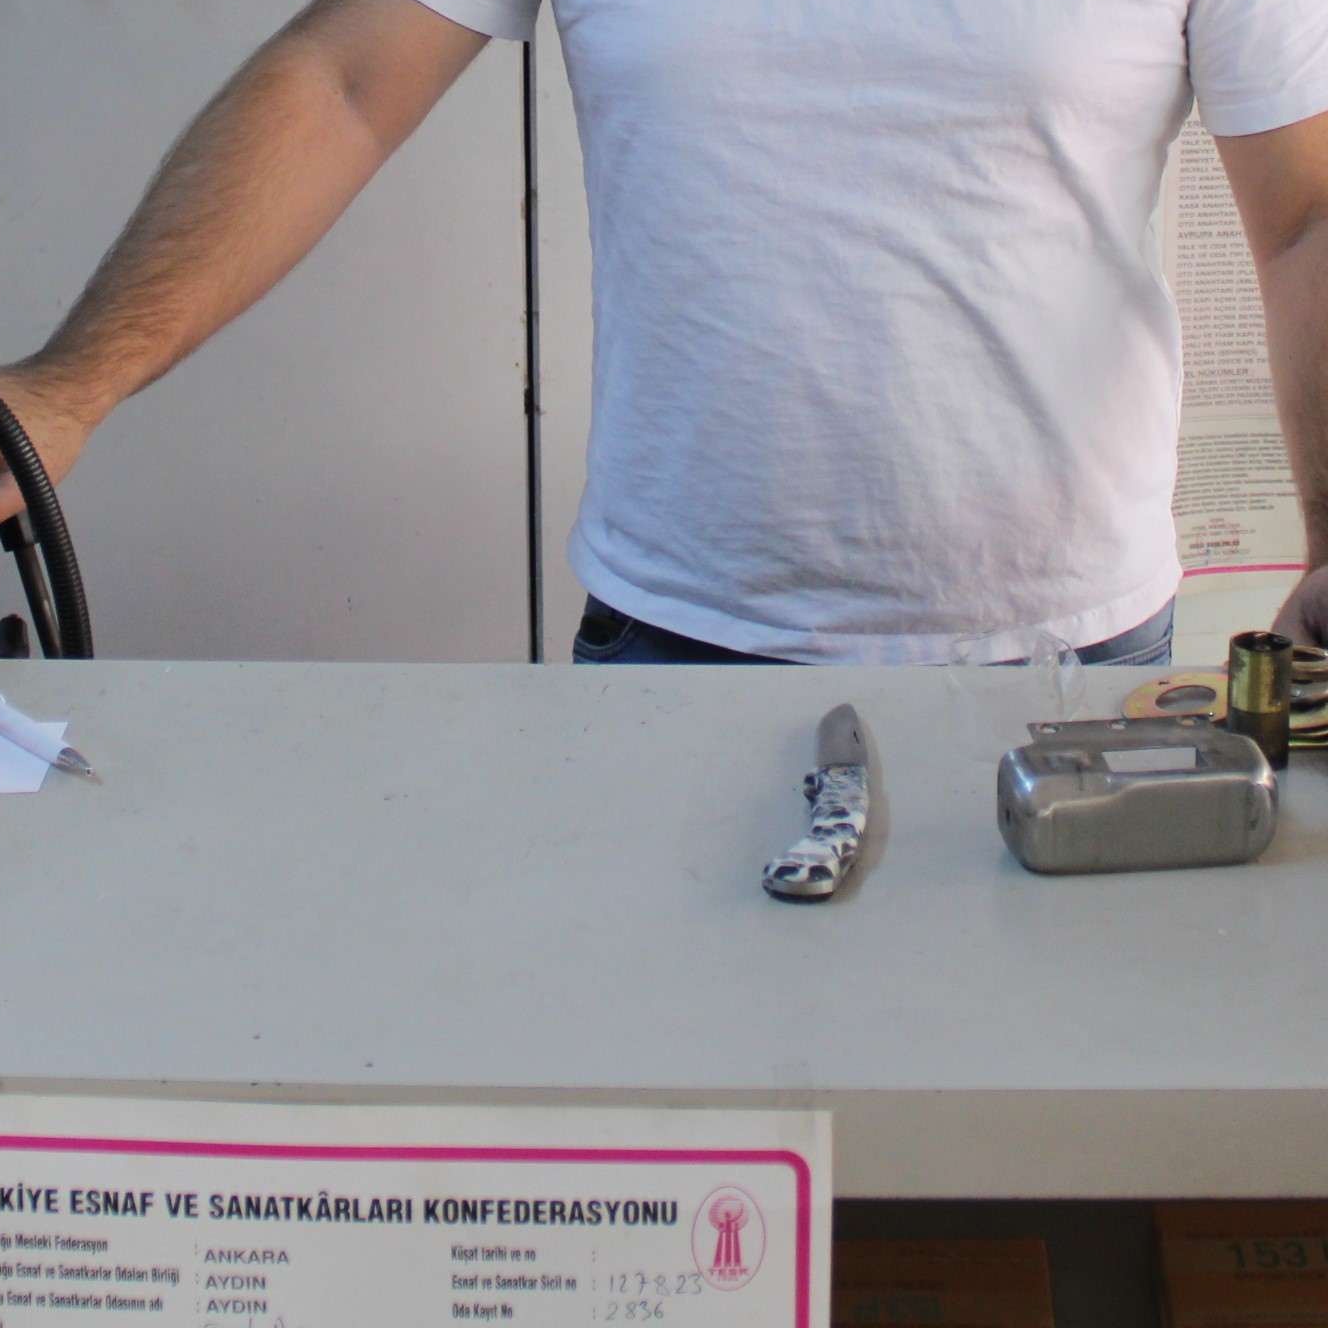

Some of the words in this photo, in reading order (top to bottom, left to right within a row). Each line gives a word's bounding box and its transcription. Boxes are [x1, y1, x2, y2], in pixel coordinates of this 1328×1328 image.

[70, 1189, 154, 1218] ESNAF
[165, 1194, 199, 1219] VE
[208, 1190, 413, 1225] SANATKÂRLARI
[423, 1198, 678, 1227] KONFEDERASYONU
[15, 1233, 52, 1250] Mesleki
[54, 1235, 108, 1255] Federasyon
[204, 1249, 289, 1265] ANKARA
[451, 1245, 478, 1265] Küşat
[481, 1246, 507, 1262] tarihi
[510, 1250, 521, 1262] ve
[524, 1250, 536, 1262] no
[1225, 1240, 1309, 1270] 153
[16, 1262, 41, 1279] Esnaf
[44, 1266, 56, 1279] ve
[58, 1263, 112, 1281] Sanatkarlar
[115, 1265, 148, 1282] Odaları
[151, 1267, 180, 1288] Birliği
[205, 1275, 266, 1290] AYDIN
[451, 1274, 478, 1291] Esnaf
[481, 1279, 492, 1290] ve
[495, 1274, 538, 1291] Sanatkar
[540, 1275, 563, 1292] Sicil
[565, 1280, 577, 1292] no
[7, 1290, 32, 1307] Esnaf
[35, 1294, 46, 1308] ve
[49, 1291, 103, 1310] Sanatkarlar
[105, 1294, 146, 1311] Odasının
[149, 1296, 163, 1311] adı
[207, 1299, 268, 1314] AYDIN
[452, 1303, 471, 1319] Oda
[473, 1304, 498, 1322] Kayıt
[501, 1305, 514, 1319] No
